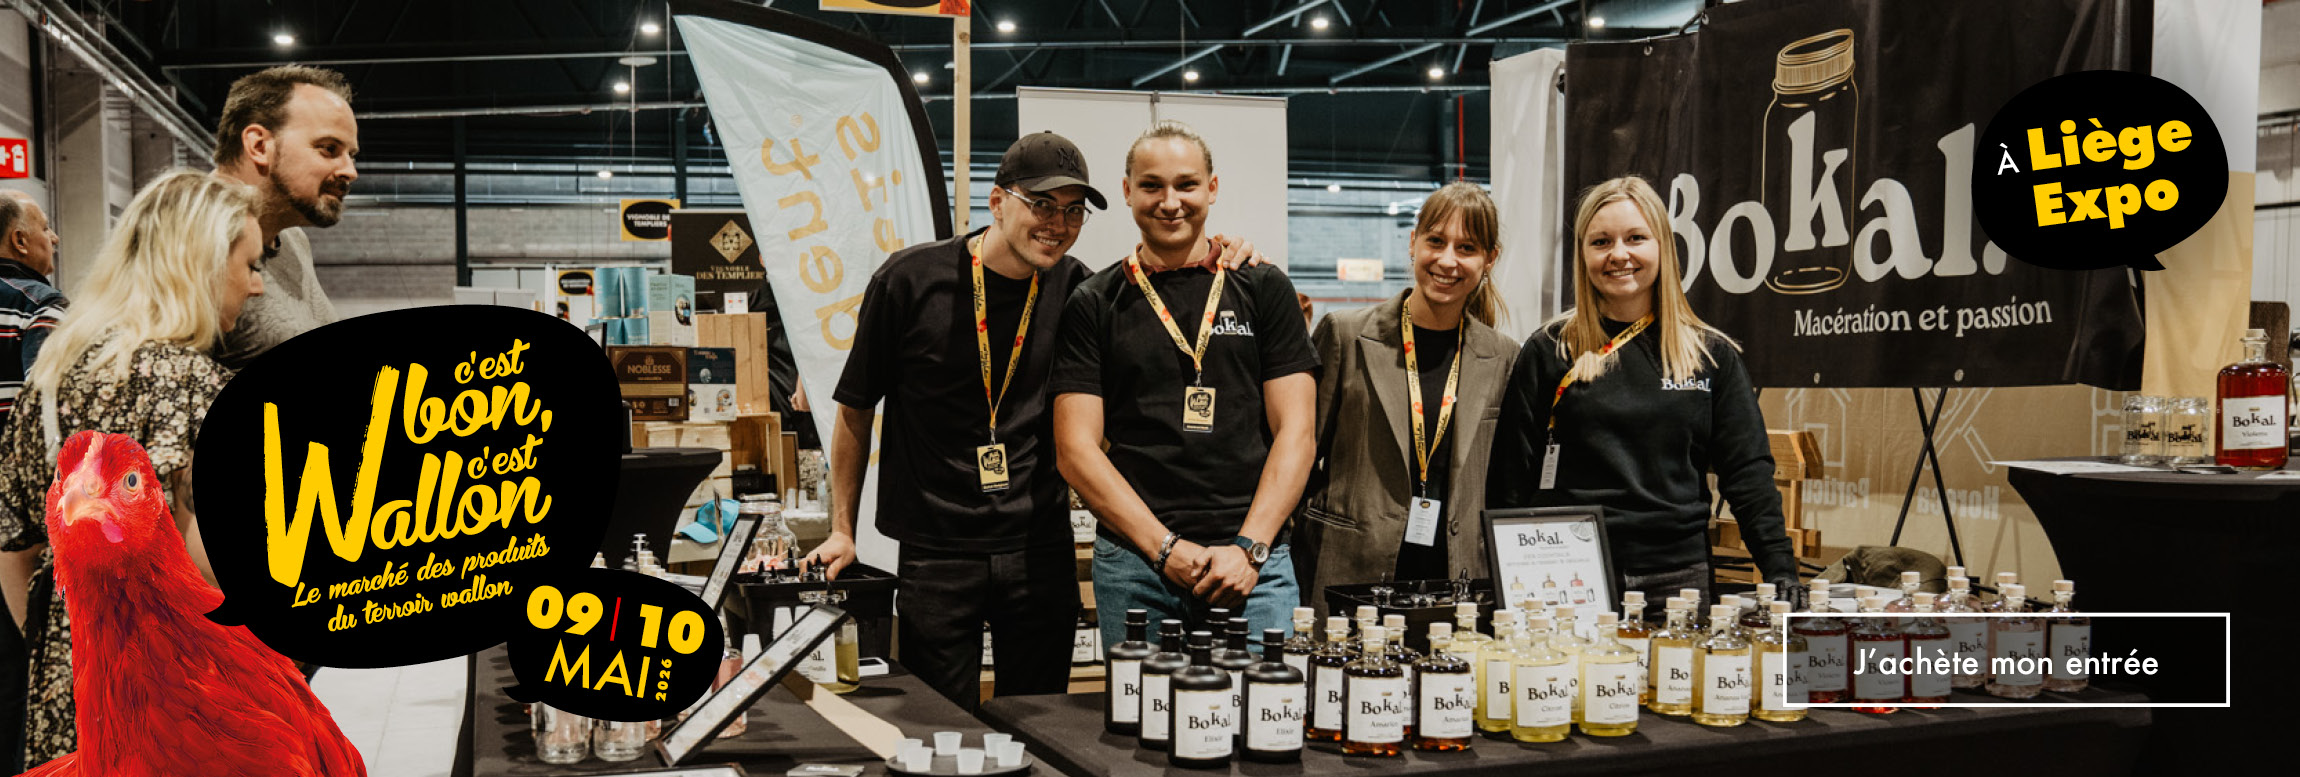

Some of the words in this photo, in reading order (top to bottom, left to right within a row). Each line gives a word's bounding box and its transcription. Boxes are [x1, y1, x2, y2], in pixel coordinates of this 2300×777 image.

[1793, 304, 1912, 336] Macération
[1918, 305, 1949, 331] et
[1955, 296, 2053, 337] passion
[627, 364, 672, 374] NOBLESSE
[1517, 529, 1563, 546] Bokal.
